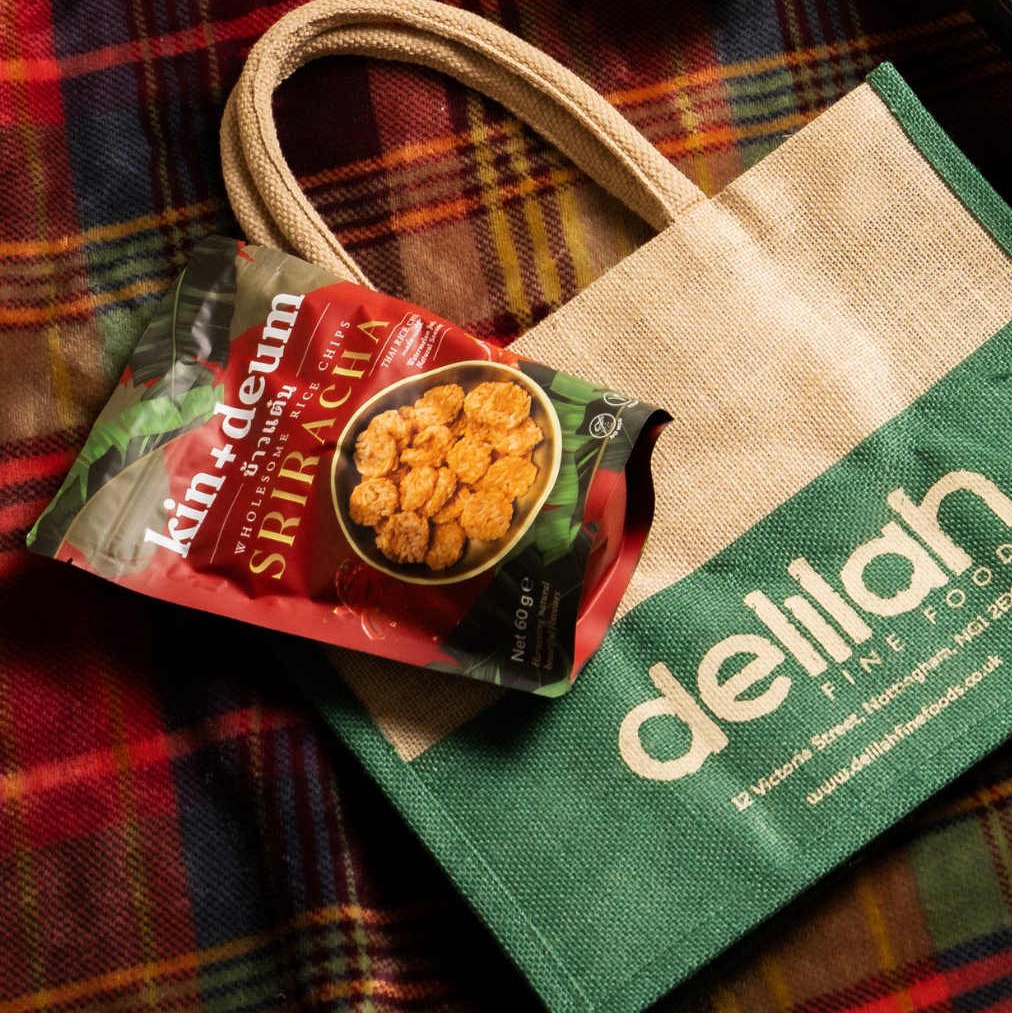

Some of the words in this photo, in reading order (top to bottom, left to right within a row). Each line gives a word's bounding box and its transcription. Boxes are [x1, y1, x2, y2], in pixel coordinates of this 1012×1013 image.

[381, 346, 398, 368] THAI
[394, 326, 410, 347] RICE
[406, 329, 431, 366] Watermelon
[415, 343, 433, 369] Natural
[234, 433, 290, 556] WHOLESOME
[290, 381, 321, 419] RICE
[317, 319, 351, 371] CHIPS
[249, 319, 391, 580] SRIRACHA
[610, 430, 618, 440] NO
[539, 580, 551, 617] natural
[547, 590, 561, 632] flavours
[511, 633, 527, 663] Net
[820, 632, 905, 701] FINE
[731, 790, 754, 812] 12
[750, 748, 813, 796] Victoria
[953, 615, 990, 647] NG1
[806, 655, 1003, 805] www.delilahfinefoods.co.uk
